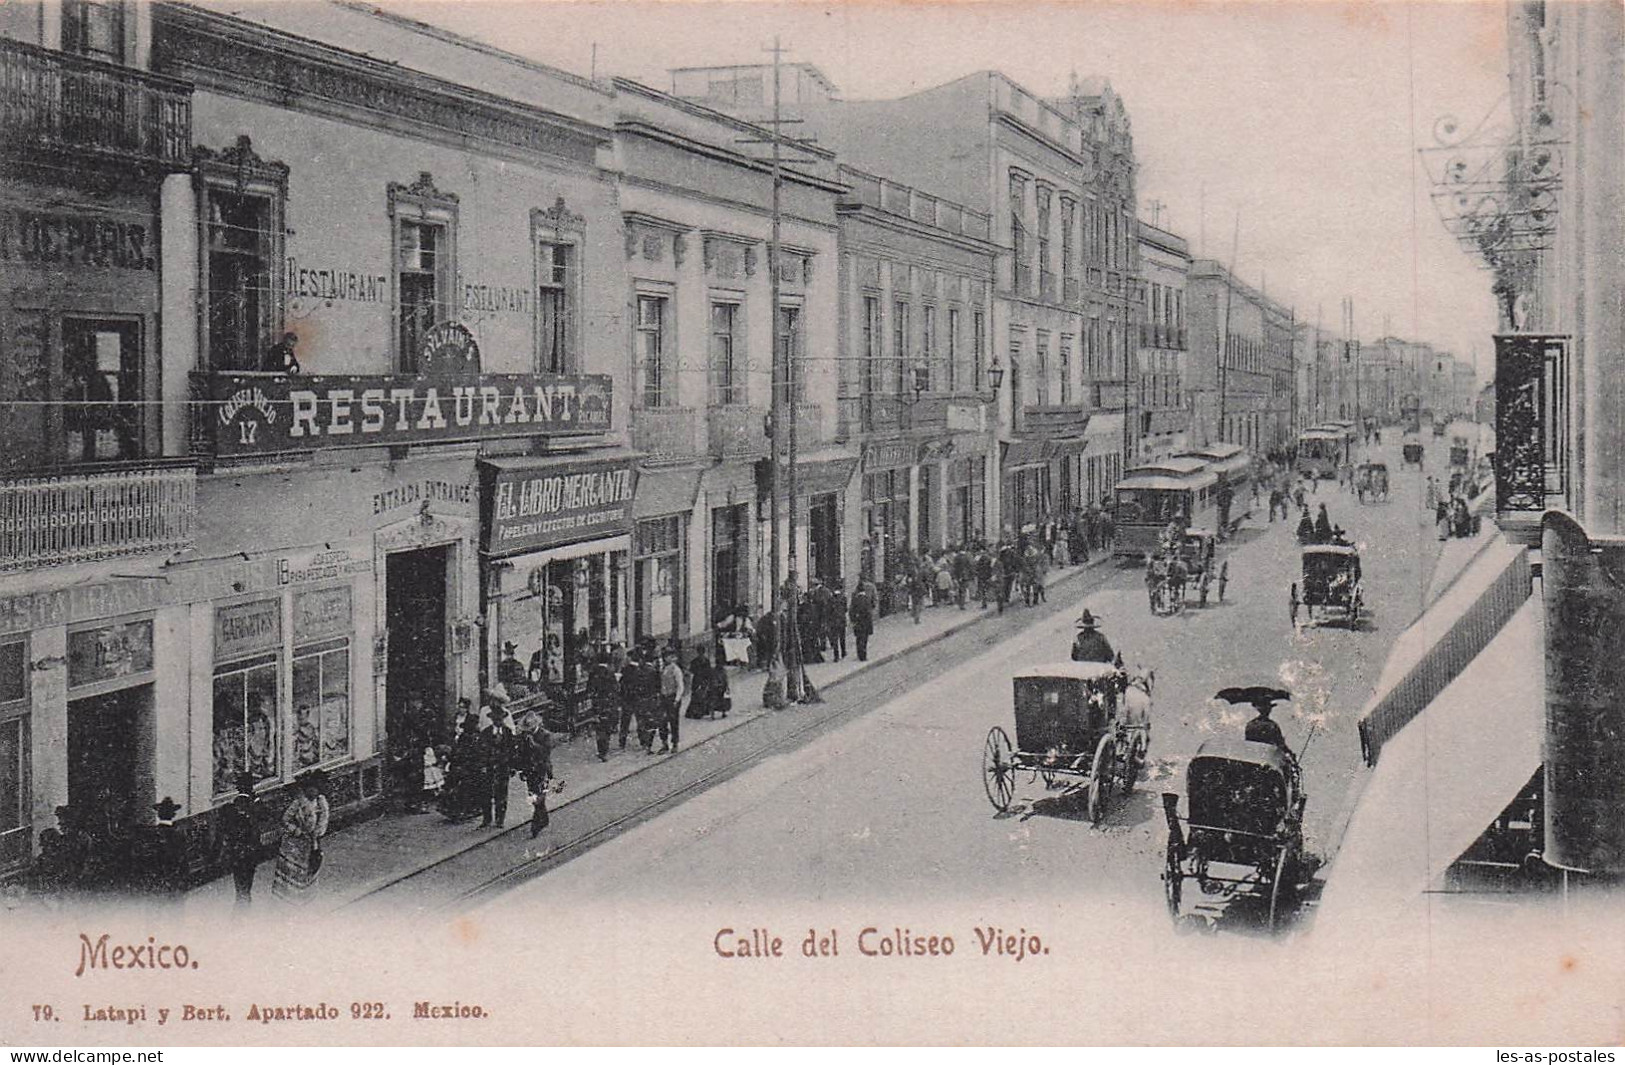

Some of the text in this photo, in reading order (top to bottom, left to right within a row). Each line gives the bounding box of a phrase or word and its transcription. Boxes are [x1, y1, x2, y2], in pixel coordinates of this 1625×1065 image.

[286, 256, 386, 303] RESTAURANT
[463, 281, 530, 313] ESTAURANT
[219, 386, 276, 425] COLISEO VIEJO
[289, 385, 576, 437] RESTAURANT
[239, 421, 257, 443] 17
[373, 480, 470, 515] ENTRADA ENTRANCE
[496, 469, 633, 520] EL LIBRO MERCANTIL
